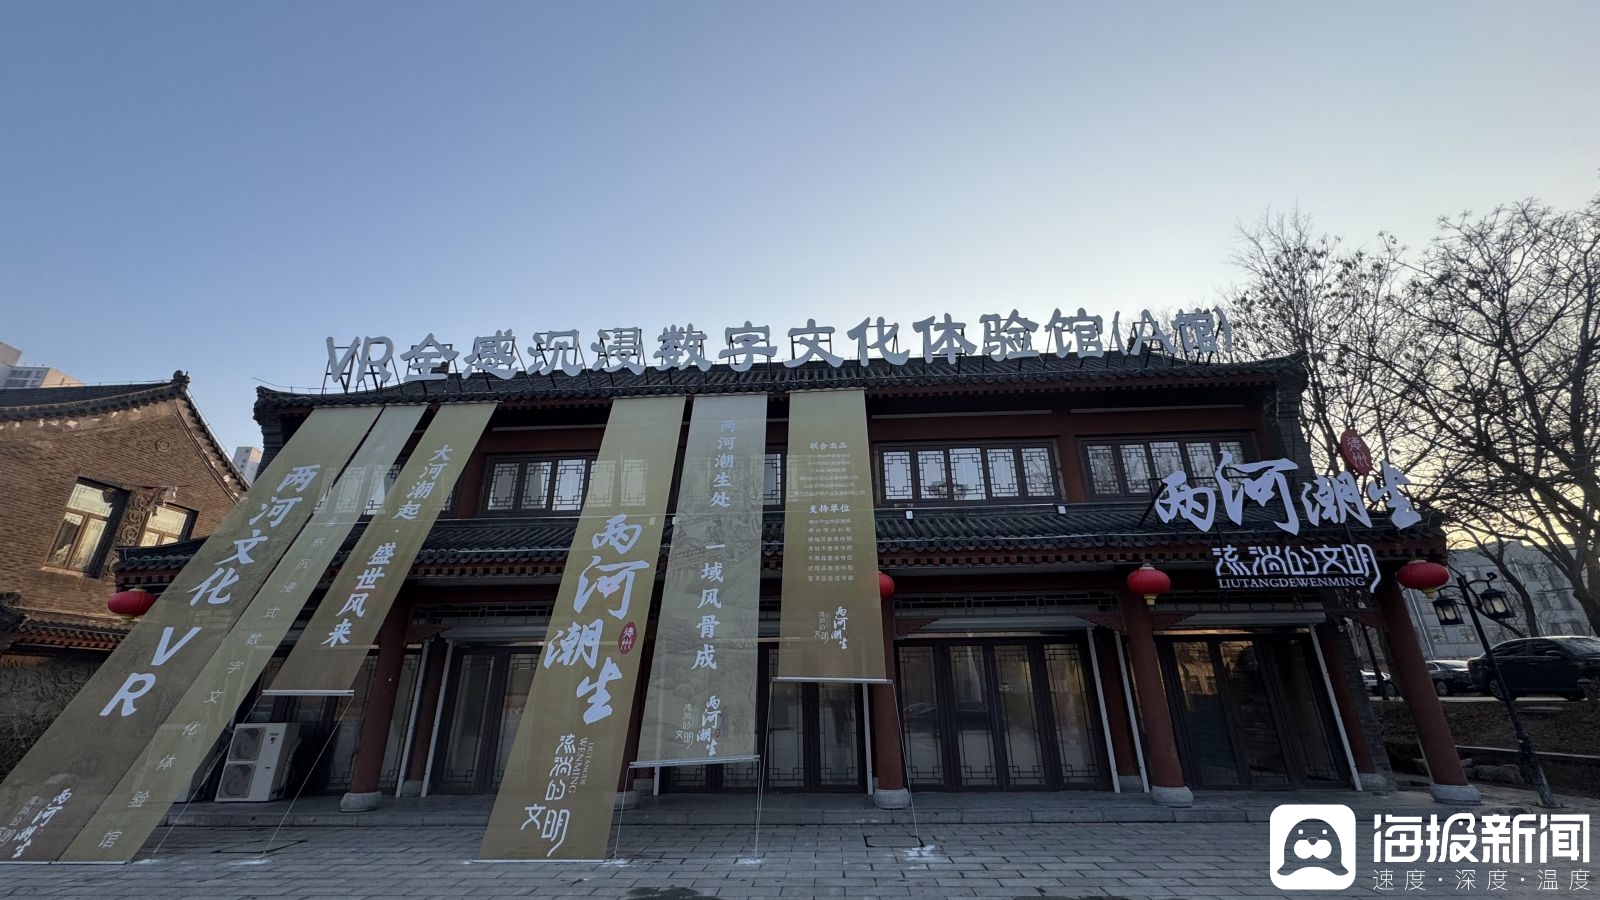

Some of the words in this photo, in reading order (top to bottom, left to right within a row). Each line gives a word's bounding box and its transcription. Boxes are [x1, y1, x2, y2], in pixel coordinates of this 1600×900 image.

[809, 503, 851, 514] 支持单位
[1155, 450, 1422, 536] 两河潮生
[1212, 543, 1381, 594] 流淌的文明
[1218, 576, 1366, 589] LIUTANGDEWENMING
[543, 513, 651, 725] 两河潮生
[568, 736, 589, 794] WENMING
[520, 733, 576, 858] 流淌的文明
